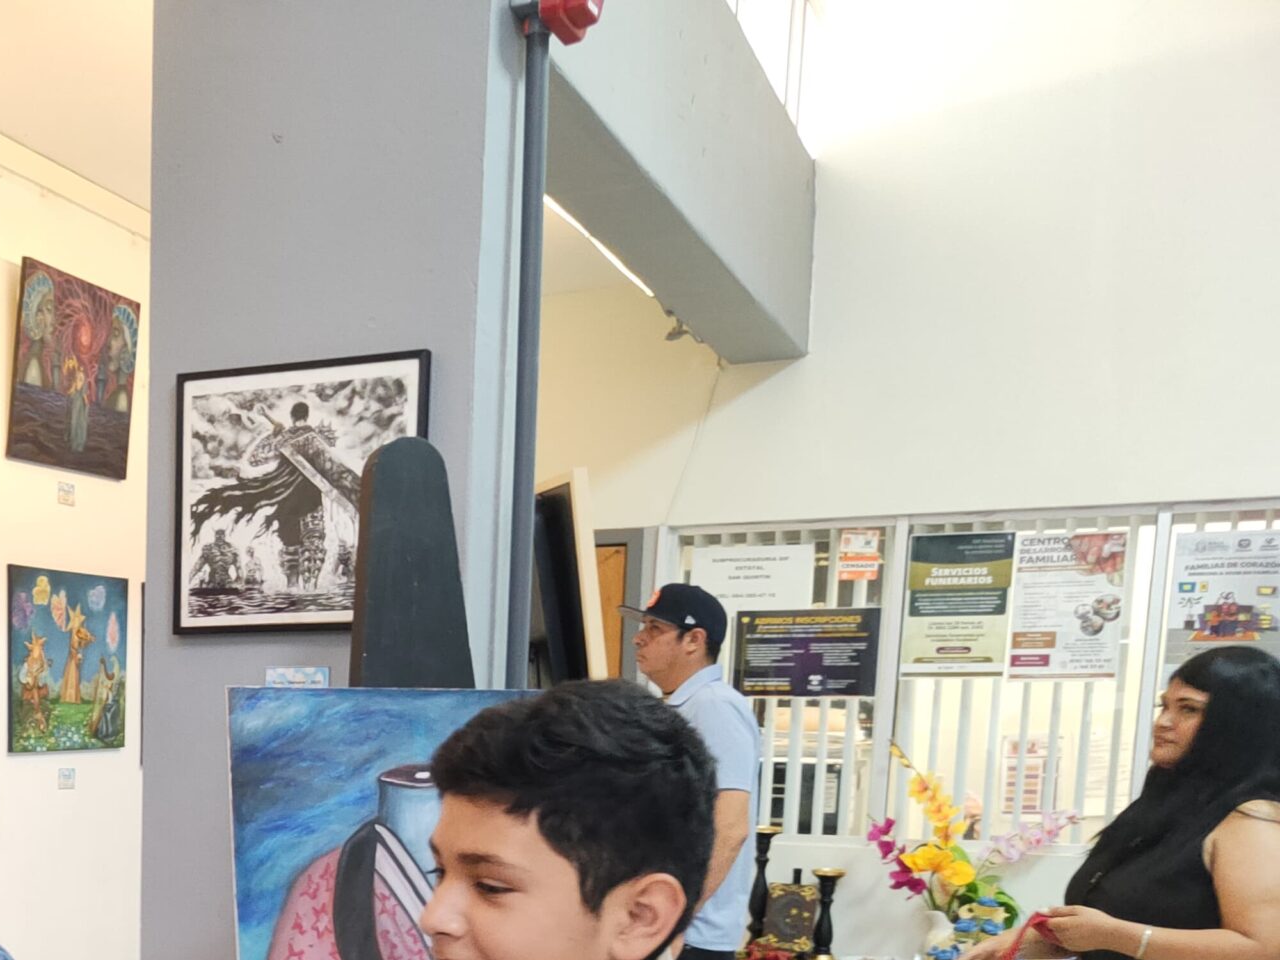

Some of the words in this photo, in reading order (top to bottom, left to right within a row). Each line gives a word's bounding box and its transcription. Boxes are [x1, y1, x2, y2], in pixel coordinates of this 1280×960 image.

[1021, 537, 1070, 547] CENTRO
[1019, 554, 1077, 564] FAMILIAR
[1184, 562, 1225, 571] FAMILIAS
[931, 567, 988, 576] SERVICIOS
[925, 576, 993, 586] FUNERARIOS
[795, 615, 862, 624] INSCRIPCIONES
